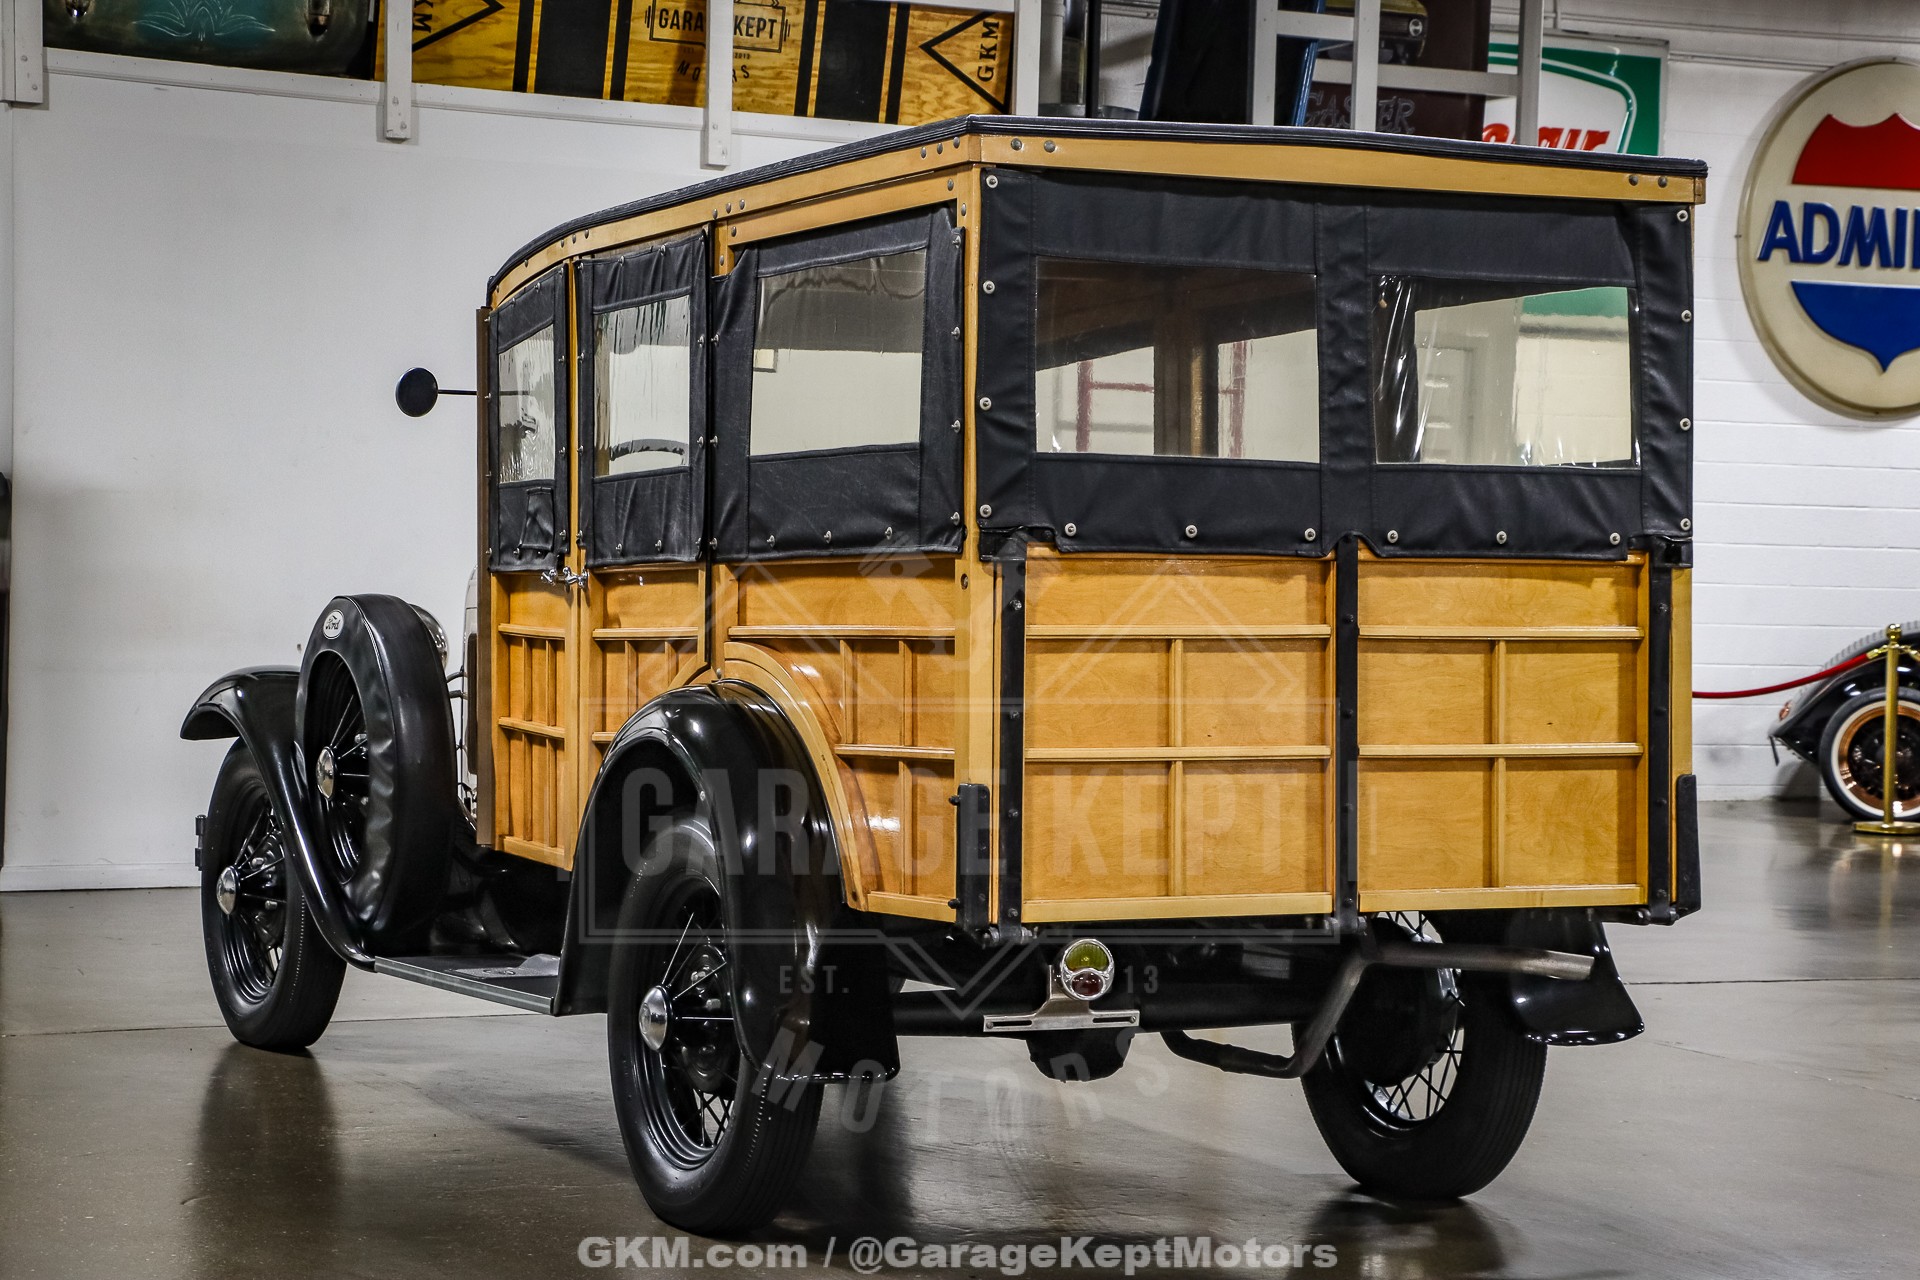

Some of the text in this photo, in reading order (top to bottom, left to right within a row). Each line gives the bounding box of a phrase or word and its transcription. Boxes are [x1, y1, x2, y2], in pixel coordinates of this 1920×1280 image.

[658, 8, 778, 39] GARA KEPT
[977, 20, 1000, 82] GKM
